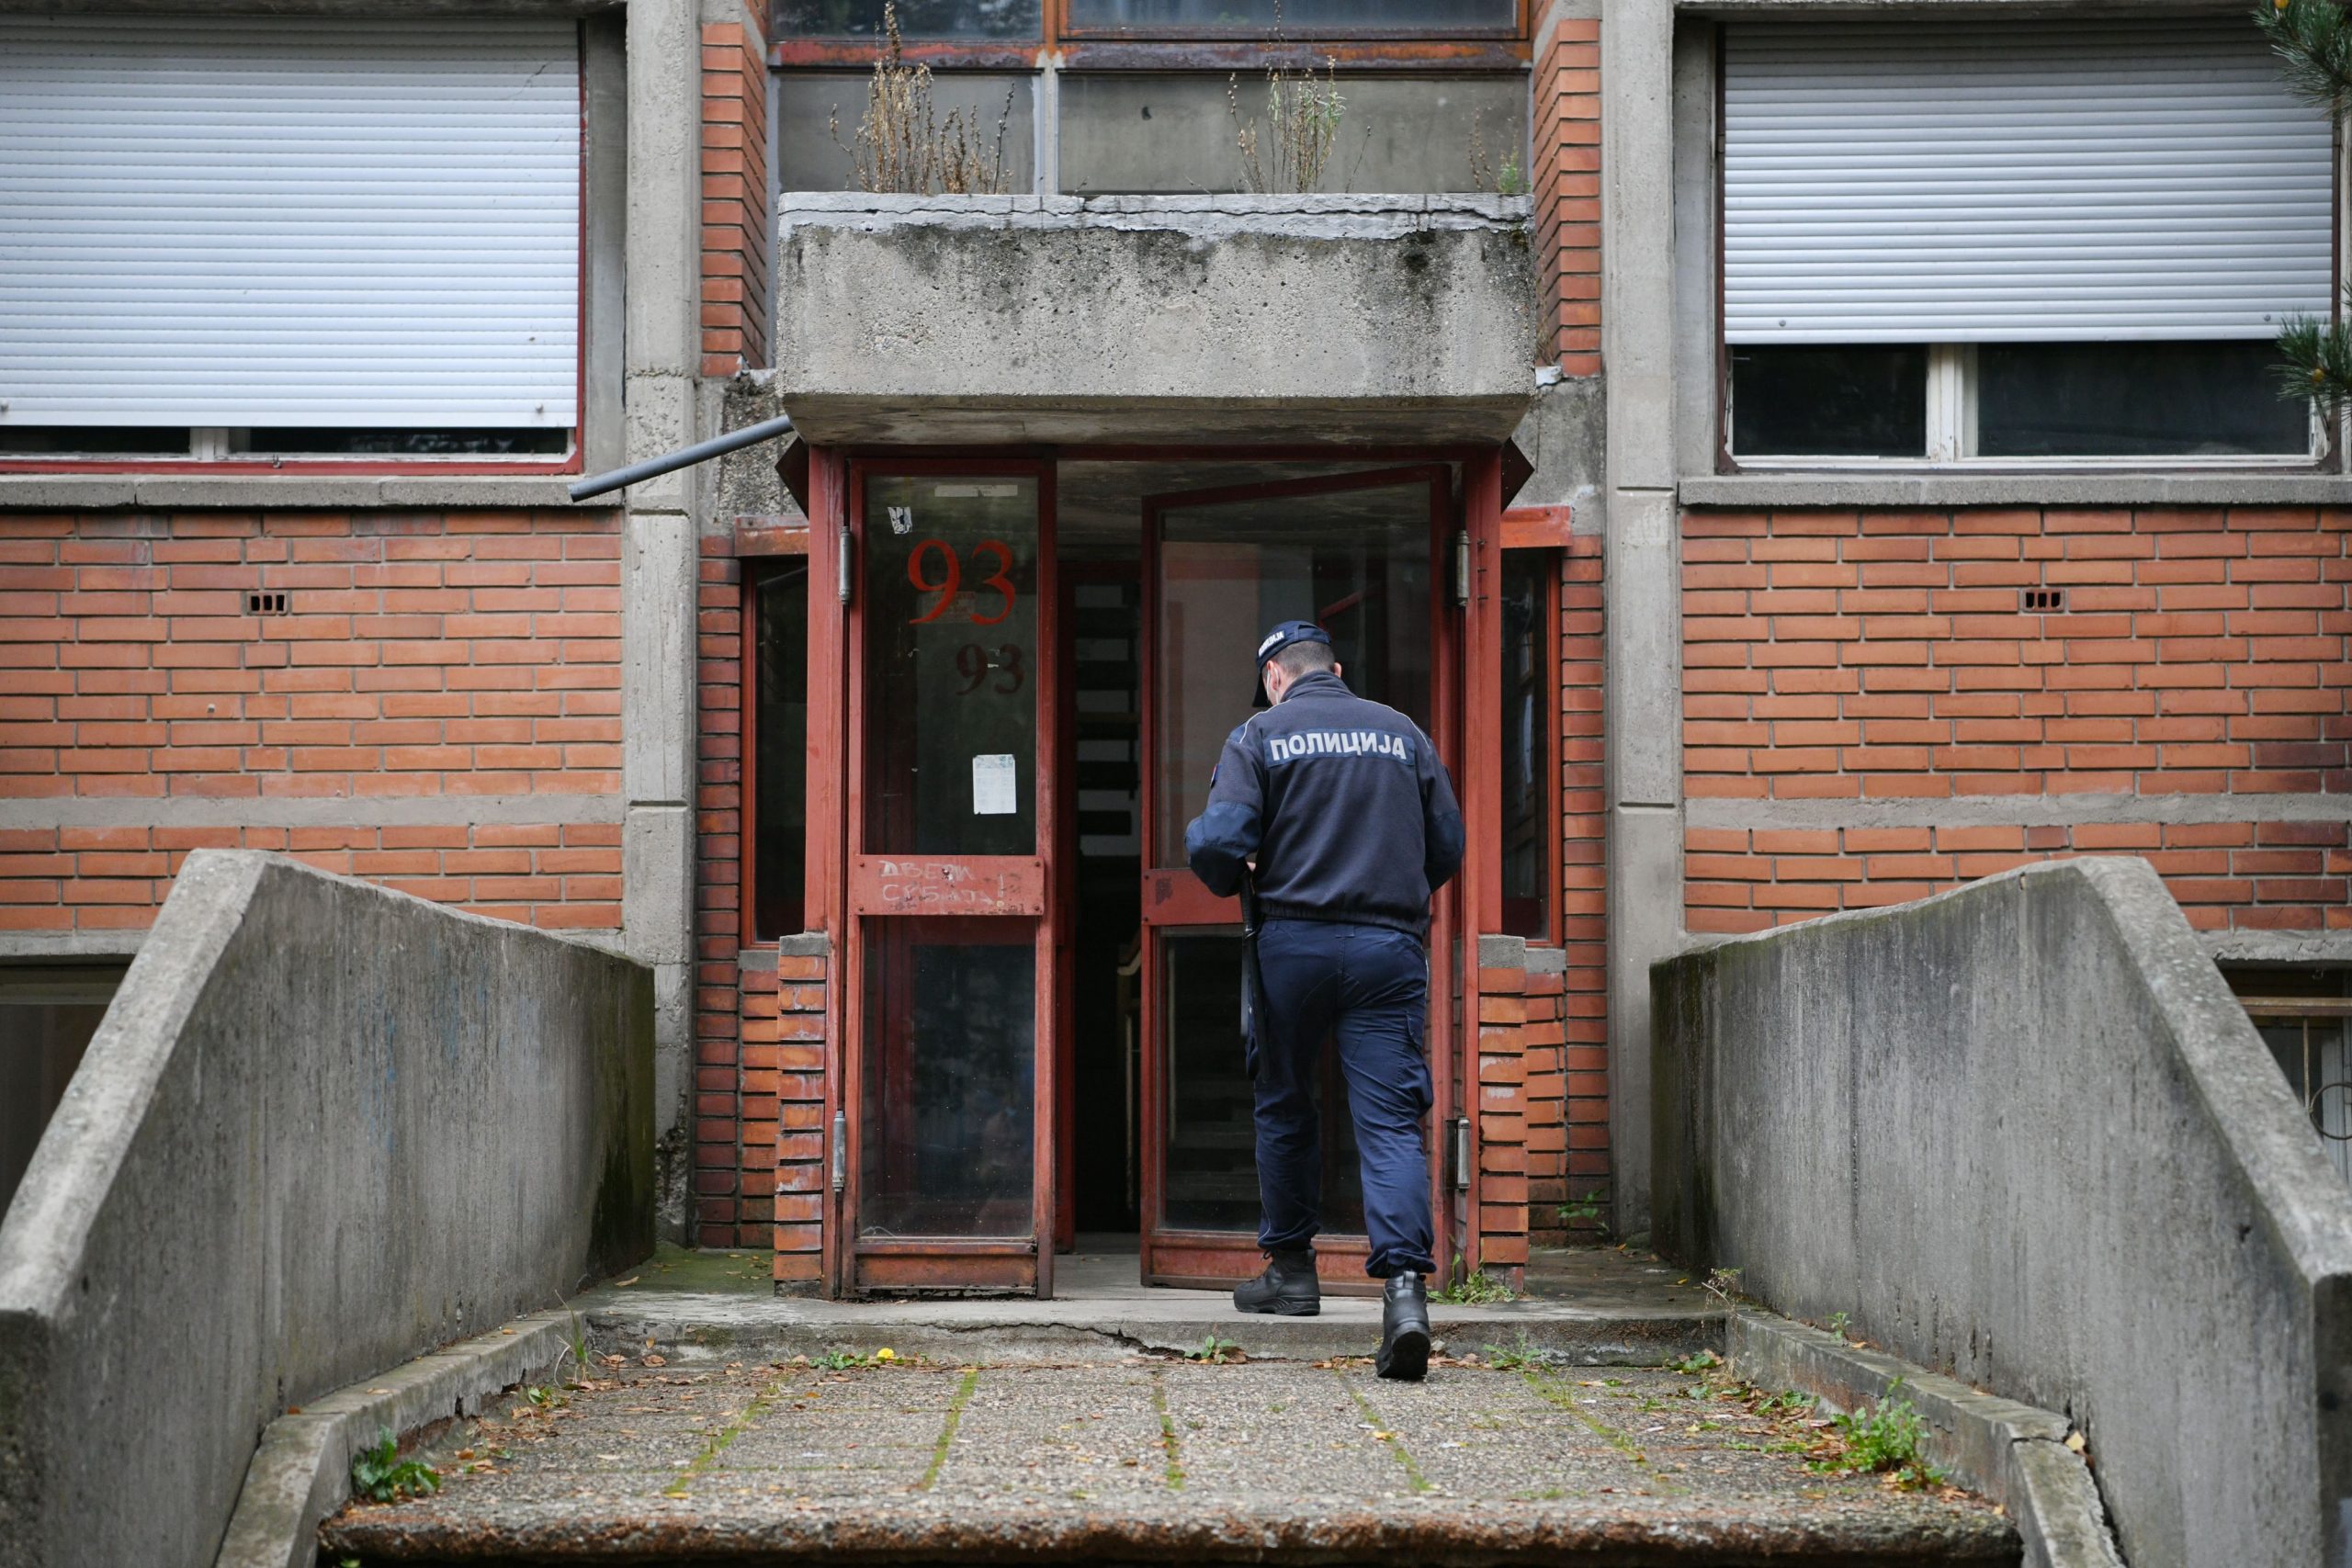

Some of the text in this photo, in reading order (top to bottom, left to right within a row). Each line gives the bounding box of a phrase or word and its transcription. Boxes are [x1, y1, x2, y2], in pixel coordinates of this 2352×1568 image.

[908, 539, 1015, 624] 93
[956, 644, 1024, 695] 93
[1270, 732, 1407, 761] ПОЛИЦИЈА
